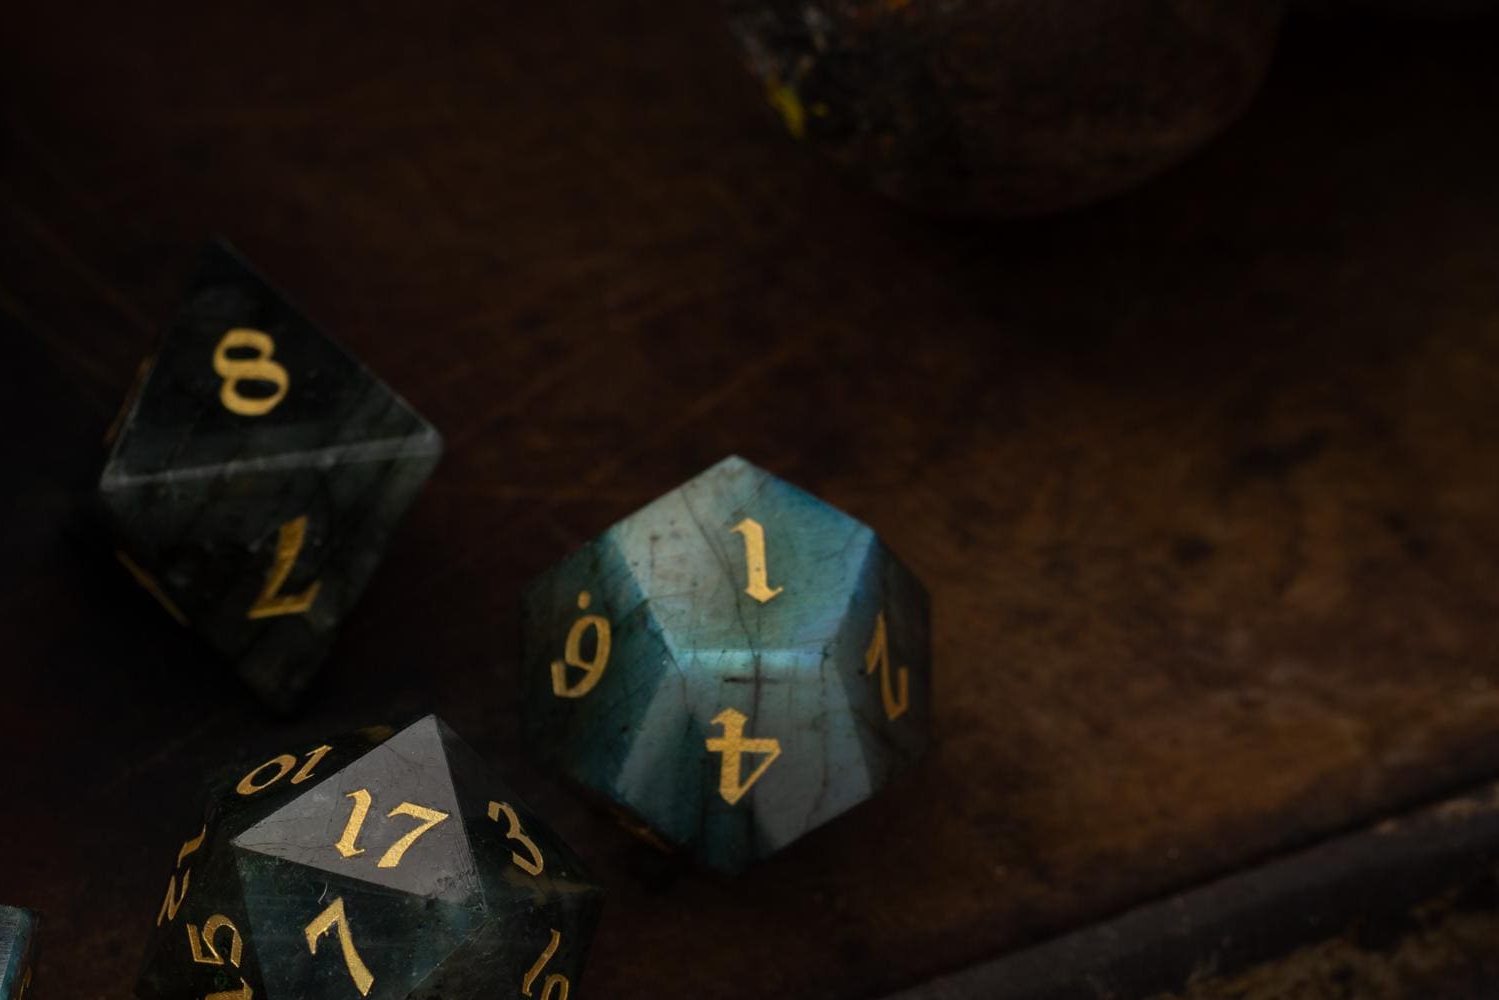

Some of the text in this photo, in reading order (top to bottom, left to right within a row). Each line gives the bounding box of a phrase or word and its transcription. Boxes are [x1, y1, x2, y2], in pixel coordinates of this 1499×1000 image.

[212, 327, 291, 417] 8
[246, 515, 323, 621] 7
[729, 517, 784, 603] 1
[236, 744, 334, 797] 10
[706, 707, 783, 806] 4
[334, 788, 450, 868] 17
[487, 800, 546, 877] 3
[304, 896, 376, 998] 7
